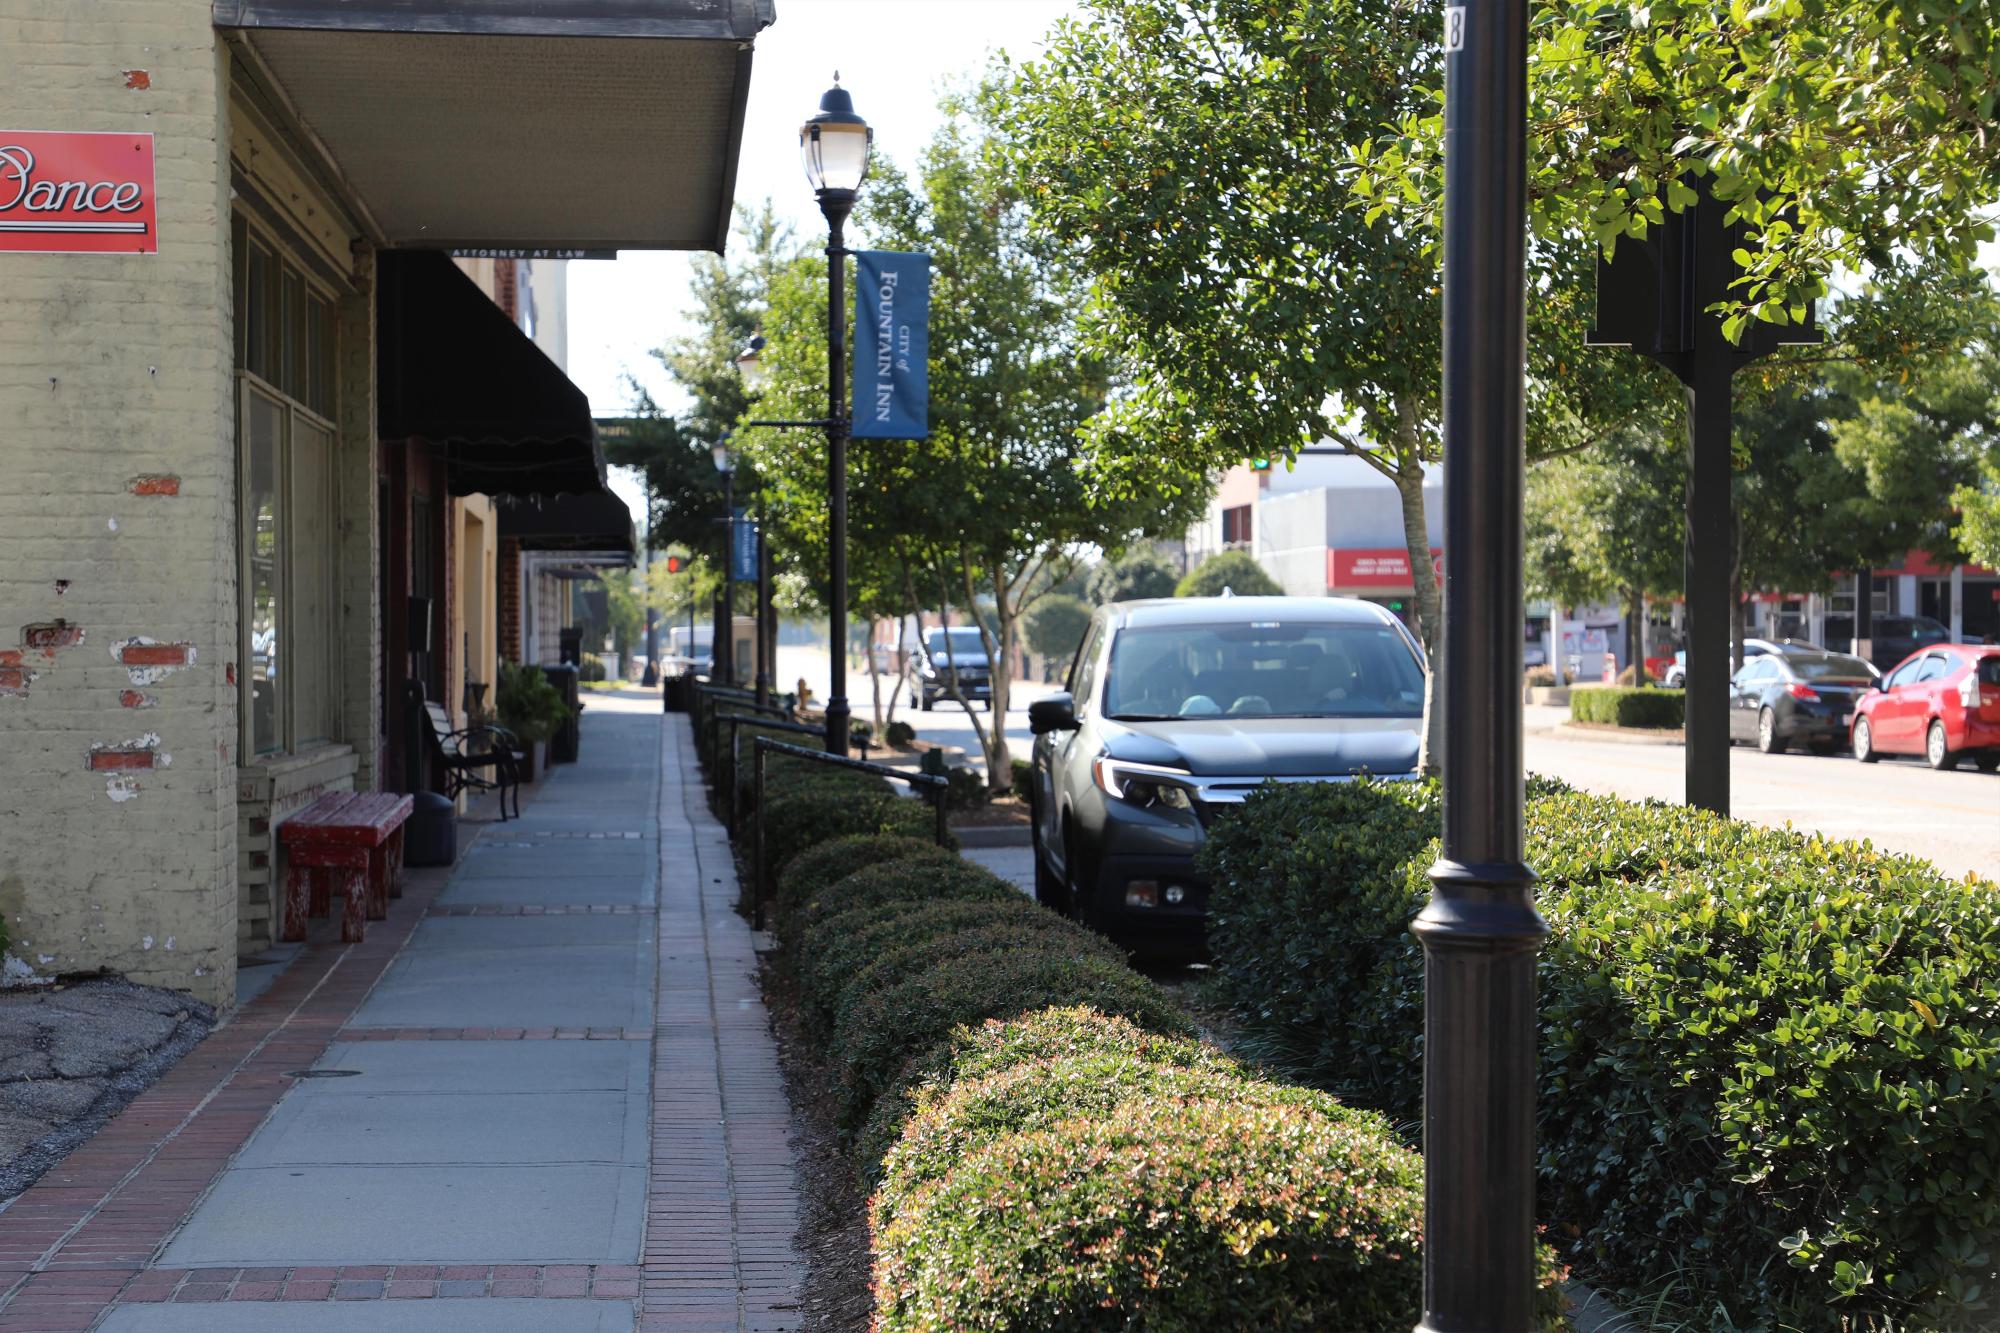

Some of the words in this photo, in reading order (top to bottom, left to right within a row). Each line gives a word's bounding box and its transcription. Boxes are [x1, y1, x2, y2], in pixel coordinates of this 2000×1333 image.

[452, 249, 526, 258] ATTORNEY
[533, 249, 549, 258] AT
[556, 249, 585, 258] LAW
[878, 271, 897, 376] FOUNTAIN
[899, 325, 910, 356] CITY
[896, 358, 911, 373] of
[876, 383, 894, 421] INN
